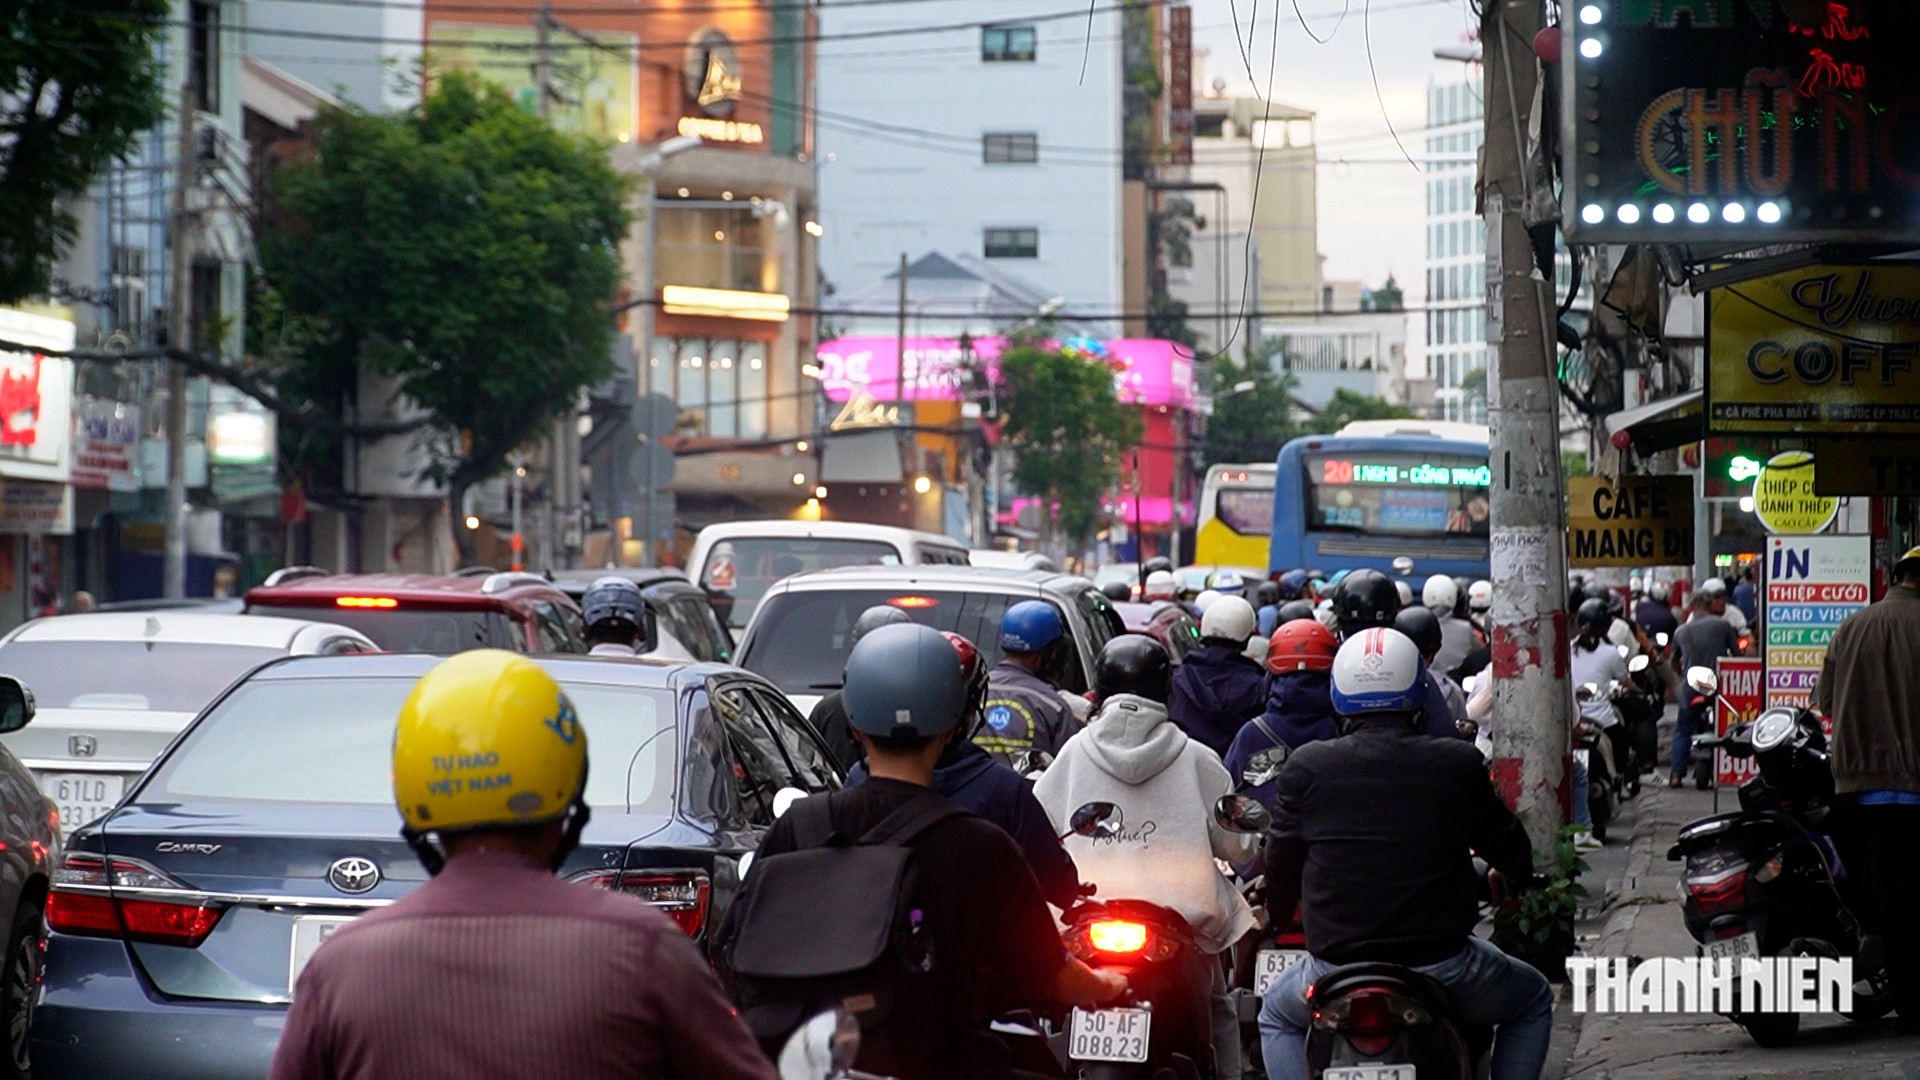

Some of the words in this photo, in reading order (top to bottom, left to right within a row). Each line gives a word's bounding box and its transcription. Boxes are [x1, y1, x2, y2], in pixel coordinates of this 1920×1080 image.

[1576, 528, 1654, 558] MANG
[1771, 583, 1816, 602] THIỆP
[1821, 582, 1863, 600] CƯỚI
[1771, 608, 1813, 621] CARD
[1770, 629, 1804, 643] GIFT
[1810, 629, 1835, 643] CA
[1720, 669, 1762, 696] THAY
[58, 778, 106, 802] 61LD
[468, 773, 513, 792] NAM
[156, 842, 222, 855] CAMRY
[1084, 1012, 1139, 1035] 50-AF
[1076, 1034, 1143, 1058] 088.23
